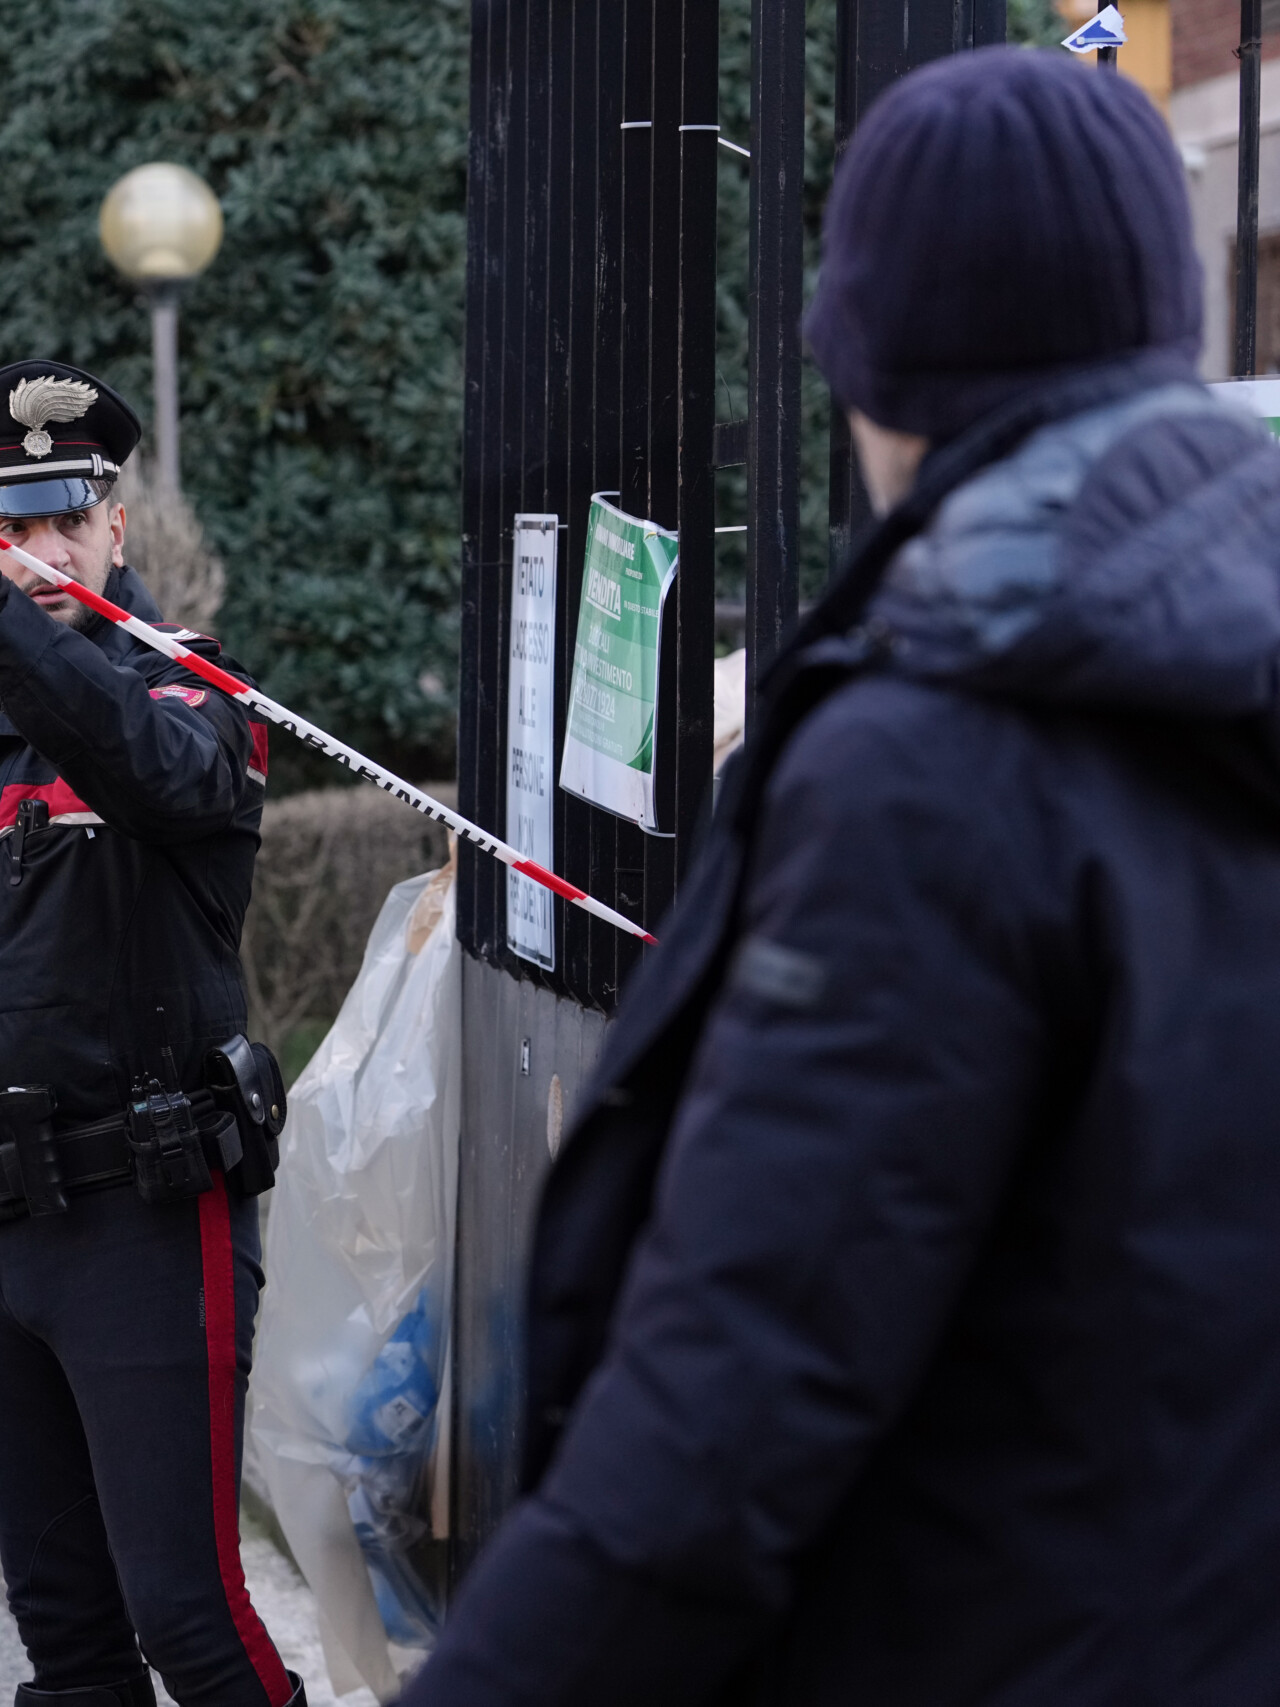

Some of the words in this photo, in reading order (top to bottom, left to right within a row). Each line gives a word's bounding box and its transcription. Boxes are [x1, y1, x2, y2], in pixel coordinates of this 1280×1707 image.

[517, 556, 545, 598] ETATO
[587, 566, 622, 615] VENDITA
[512, 747, 545, 797] PERSONE
